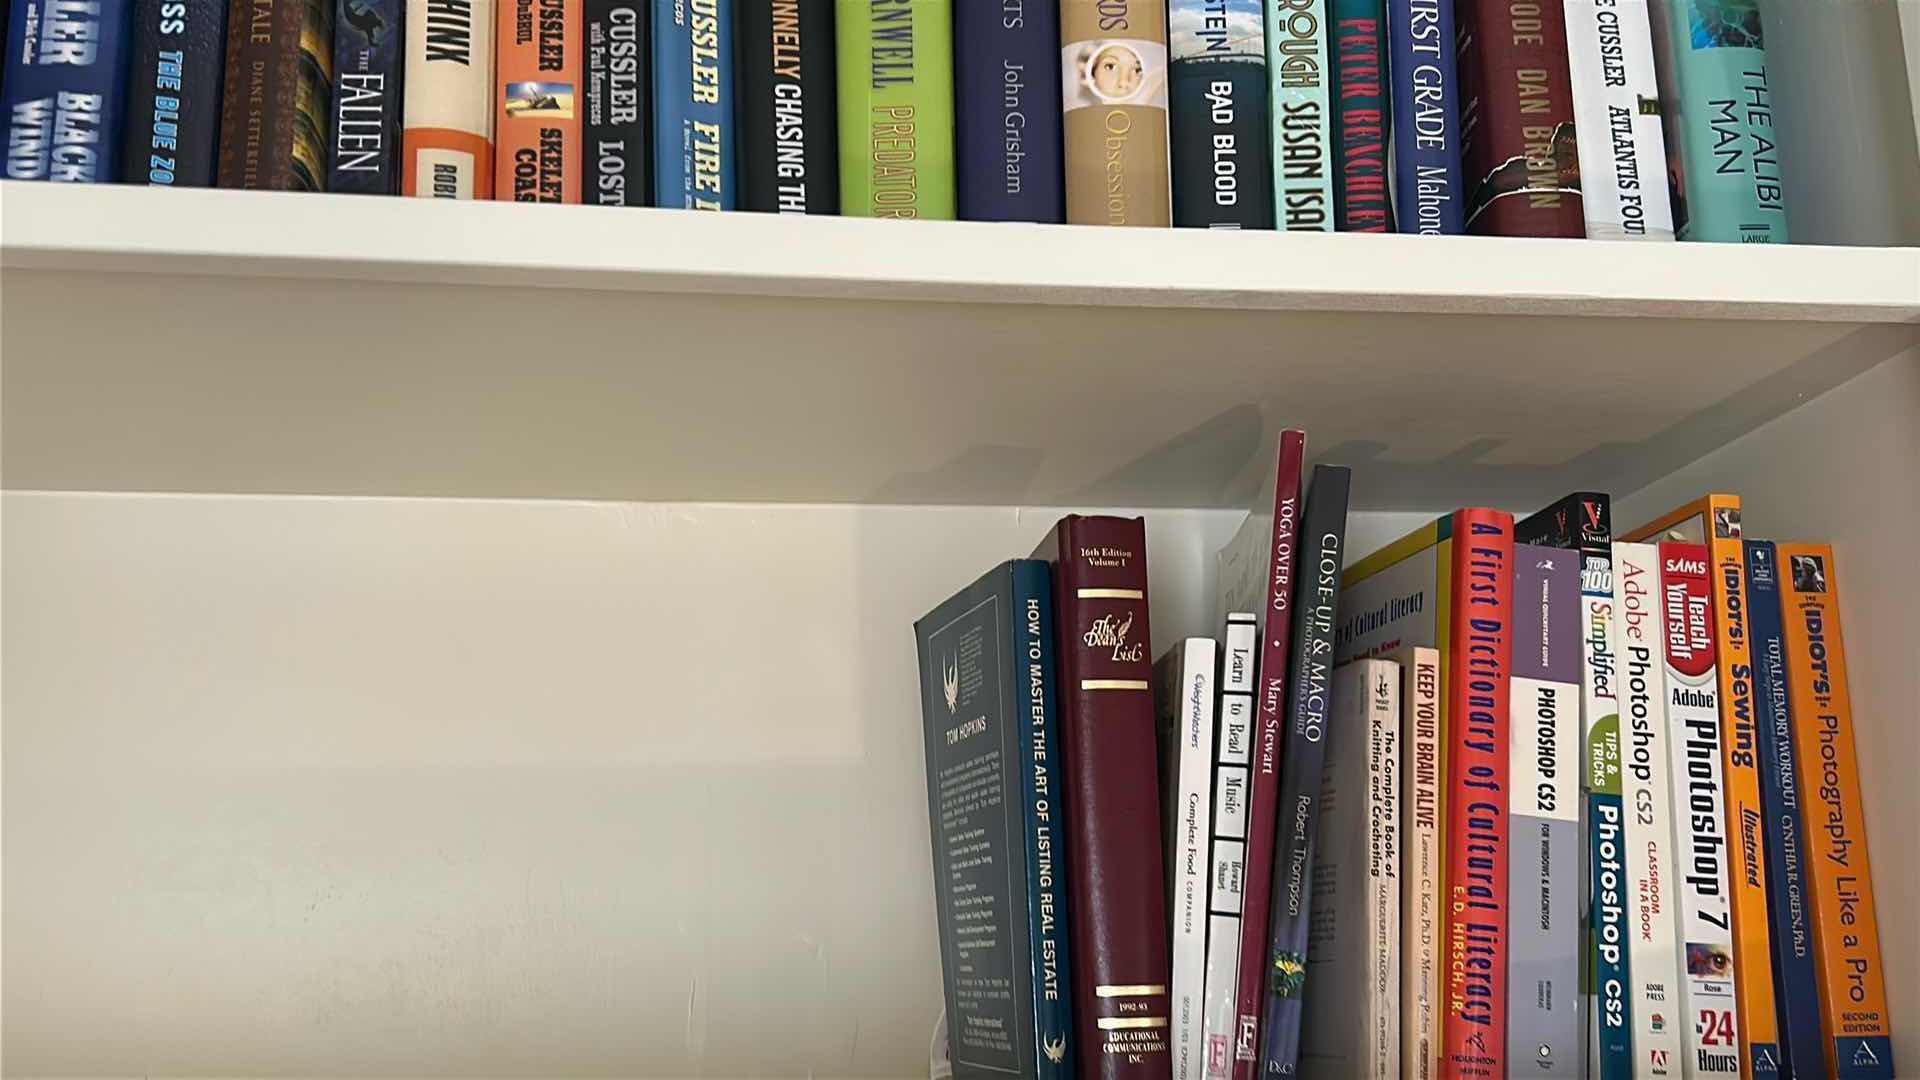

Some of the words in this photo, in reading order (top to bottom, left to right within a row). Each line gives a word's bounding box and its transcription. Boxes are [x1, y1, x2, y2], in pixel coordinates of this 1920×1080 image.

[591, 22, 606, 45] with
[1597, 11, 1626, 87] CUSSLER
[157, 51, 183, 91] THE
[358, 50, 369, 72] THE
[591, 46, 606, 69] Paul
[609, 7, 637, 126] CUSSLER
[1340, 18, 1381, 99] PETER
[249, 61, 265, 103] DIANE
[1004, 59, 1024, 108] John
[1204, 81, 1235, 125] BAD
[1515, 68, 1551, 113] DAN
[1743, 65, 1772, 127] THE
[152, 96, 180, 151] BLUE
[337, 73, 385, 173] FALLEN
[1412, 64, 1445, 151] GRADE
[7, 96, 53, 180] WIND
[49, 91, 102, 183] BLACK
[774, 83, 805, 179] CHASING
[1004, 111, 1026, 194] Grisham
[1281, 101, 1323, 179] SUSAN
[1608, 104, 1639, 190] ATLANTIS
[1708, 99, 1745, 174] MAN
[598, 140, 625, 206] LOST
[693, 120, 721, 194] FIRE
[873, 105, 917, 219] PREDATOR
[1105, 110, 1132, 226] Obsession
[1213, 134, 1238, 206] BLOOD
[1522, 126, 1561, 209] BROWN
[1750, 133, 1784, 211] ALIBI
[1279, 497, 1295, 540] YOGA
[1471, 522, 1504, 537] A
[1581, 532, 1610, 544] Visual
[1081, 547, 1100, 558] 16th
[1101, 547, 1132, 558] Edition
[1088, 557, 1120, 567] Volume
[1275, 543, 1291, 585] OVER
[1586, 556, 1610, 571] TOP
[1665, 558, 1707, 575] SAMS
[1314, 532, 1339, 633] CLOSE-UP
[1470, 546, 1504, 607] First
[1541, 578, 1550, 602] VISUAL
[1581, 569, 1613, 593] 100
[1026, 599, 1040, 636] HOW
[1273, 590, 1287, 611] 50
[1354, 599, 1388, 637] Cultural
[1389, 591, 1424, 622] Literacy
[1622, 559, 1650, 641] Adobe
[1665, 582, 1693, 661] Yourself
[1724, 568, 1744, 641] IDIOT'S
[1688, 594, 1712, 651] Teach
[1030, 640, 1042, 659] TO
[1231, 647, 1248, 684] Learn
[1312, 638, 1332, 656] &
[1541, 646, 1550, 668] GUIDE
[1585, 601, 1618, 701] Simplified
[1767, 636, 1782, 678] TOTAL
[1805, 609, 1831, 694] IDIOT'S
[1030, 663, 1045, 726] MASTER
[1263, 677, 1281, 716] Mary
[1304, 661, 1327, 743] MACRO
[1416, 662, 1435, 698] KEEP
[1464, 617, 1503, 755] Dictionary
[1672, 688, 1715, 709] Adobe
[946, 728, 960, 745] TOM
[960, 715, 987, 740] HOPKINS
[1230, 702, 1244, 716] to
[1296, 703, 1306, 736] GUIDE
[1416, 702, 1435, 738] YOUR
[1628, 645, 1656, 782] Photoshop
[1772, 679, 1788, 741] MEMORY
[1033, 729, 1047, 761] THE
[1227, 723, 1245, 755] Read
[1261, 718, 1279, 775] Stewart
[1371, 719, 1383, 772] Knitting
[1385, 729, 1396, 756] The
[1537, 686, 1557, 779] PHOTOSHOP
[1604, 731, 1618, 761] TIPS
[1035, 764, 1048, 796] ART
[1416, 741, 1435, 786] BRAIN
[1464, 764, 1501, 792] of
[1592, 741, 1606, 787] TRICKS
[1605, 763, 1619, 776] &
[1731, 663, 1755, 769] Sewing
[1743, 808, 1762, 889] Illustrated
[1779, 739, 1797, 809] WORKOUT
[1224, 776, 1242, 815] Music
[1371, 775, 1382, 806] and
[1382, 757, 1397, 819] Complete
[1416, 788, 1435, 829] ALIVE
[1537, 783, 1557, 812] CS2
[1635, 787, 1655, 827] CS2
[1684, 718, 1724, 897] Photoshop
[1817, 714, 1851, 868] Photography
[1036, 799, 1050, 822] OF
[1186, 792, 1199, 845] Complete
[1295, 794, 1312, 842] Robert
[1540, 822, 1551, 838] FOR
[1038, 826, 1053, 887] LISTING
[1186, 848, 1198, 876] Food
[1370, 806, 1382, 877] Crocheting
[1384, 824, 1396, 858] Book
[1421, 831, 1433, 877] Lawrence
[1465, 802, 1501, 911] Cultural
[1540, 840, 1551, 878] WINDOWS
[1782, 814, 1798, 872] CYNTHIA
[1230, 860, 1242, 893] Howard
[1287, 846, 1307, 916] Thompson
[1385, 862, 1396, 878] of
[1421, 879, 1432, 892] C.
[1598, 804, 1623, 966] Photoshop
[1639, 879, 1648, 892] IN
[1646, 840, 1661, 914] CLASSROOM
[1041, 892, 1054, 934] REAL
[1184, 880, 1193, 935] COMPANION
[1539, 886, 1551, 931] MACINTOSH
[1639, 894, 1649, 903] A
[1697, 908, 1729, 931] 7
[1788, 884, 1803, 930] GREEN,
[1836, 875, 1860, 925] Like
[1421, 918, 1432, 946] Ph.D.
[1640, 905, 1652, 941] BOOK
[1793, 929, 1807, 959] Ph.D.
[1843, 934, 1858, 948] a
[1043, 939, 1058, 1001] ESTATE
[1451, 921, 1466, 988] HIRSCH,
[1461, 922, 1500, 1027] Literacy
[1646, 992, 1665, 1001] PRESS
[1703, 983, 1722, 993] Rose
[1845, 958, 1868, 1002] Pro
[1450, 991, 1464, 1018] JR.
[1605, 978, 1623, 1027] CS2
[1841, 1012, 1879, 1021] SECOND
[1108, 1031, 1160, 1042] EDUCATIONAL
[1700, 1009, 1736, 1046] 24
[1843, 1023, 1881, 1032] EDITION
[1697, 1048, 1738, 1073] Hours
